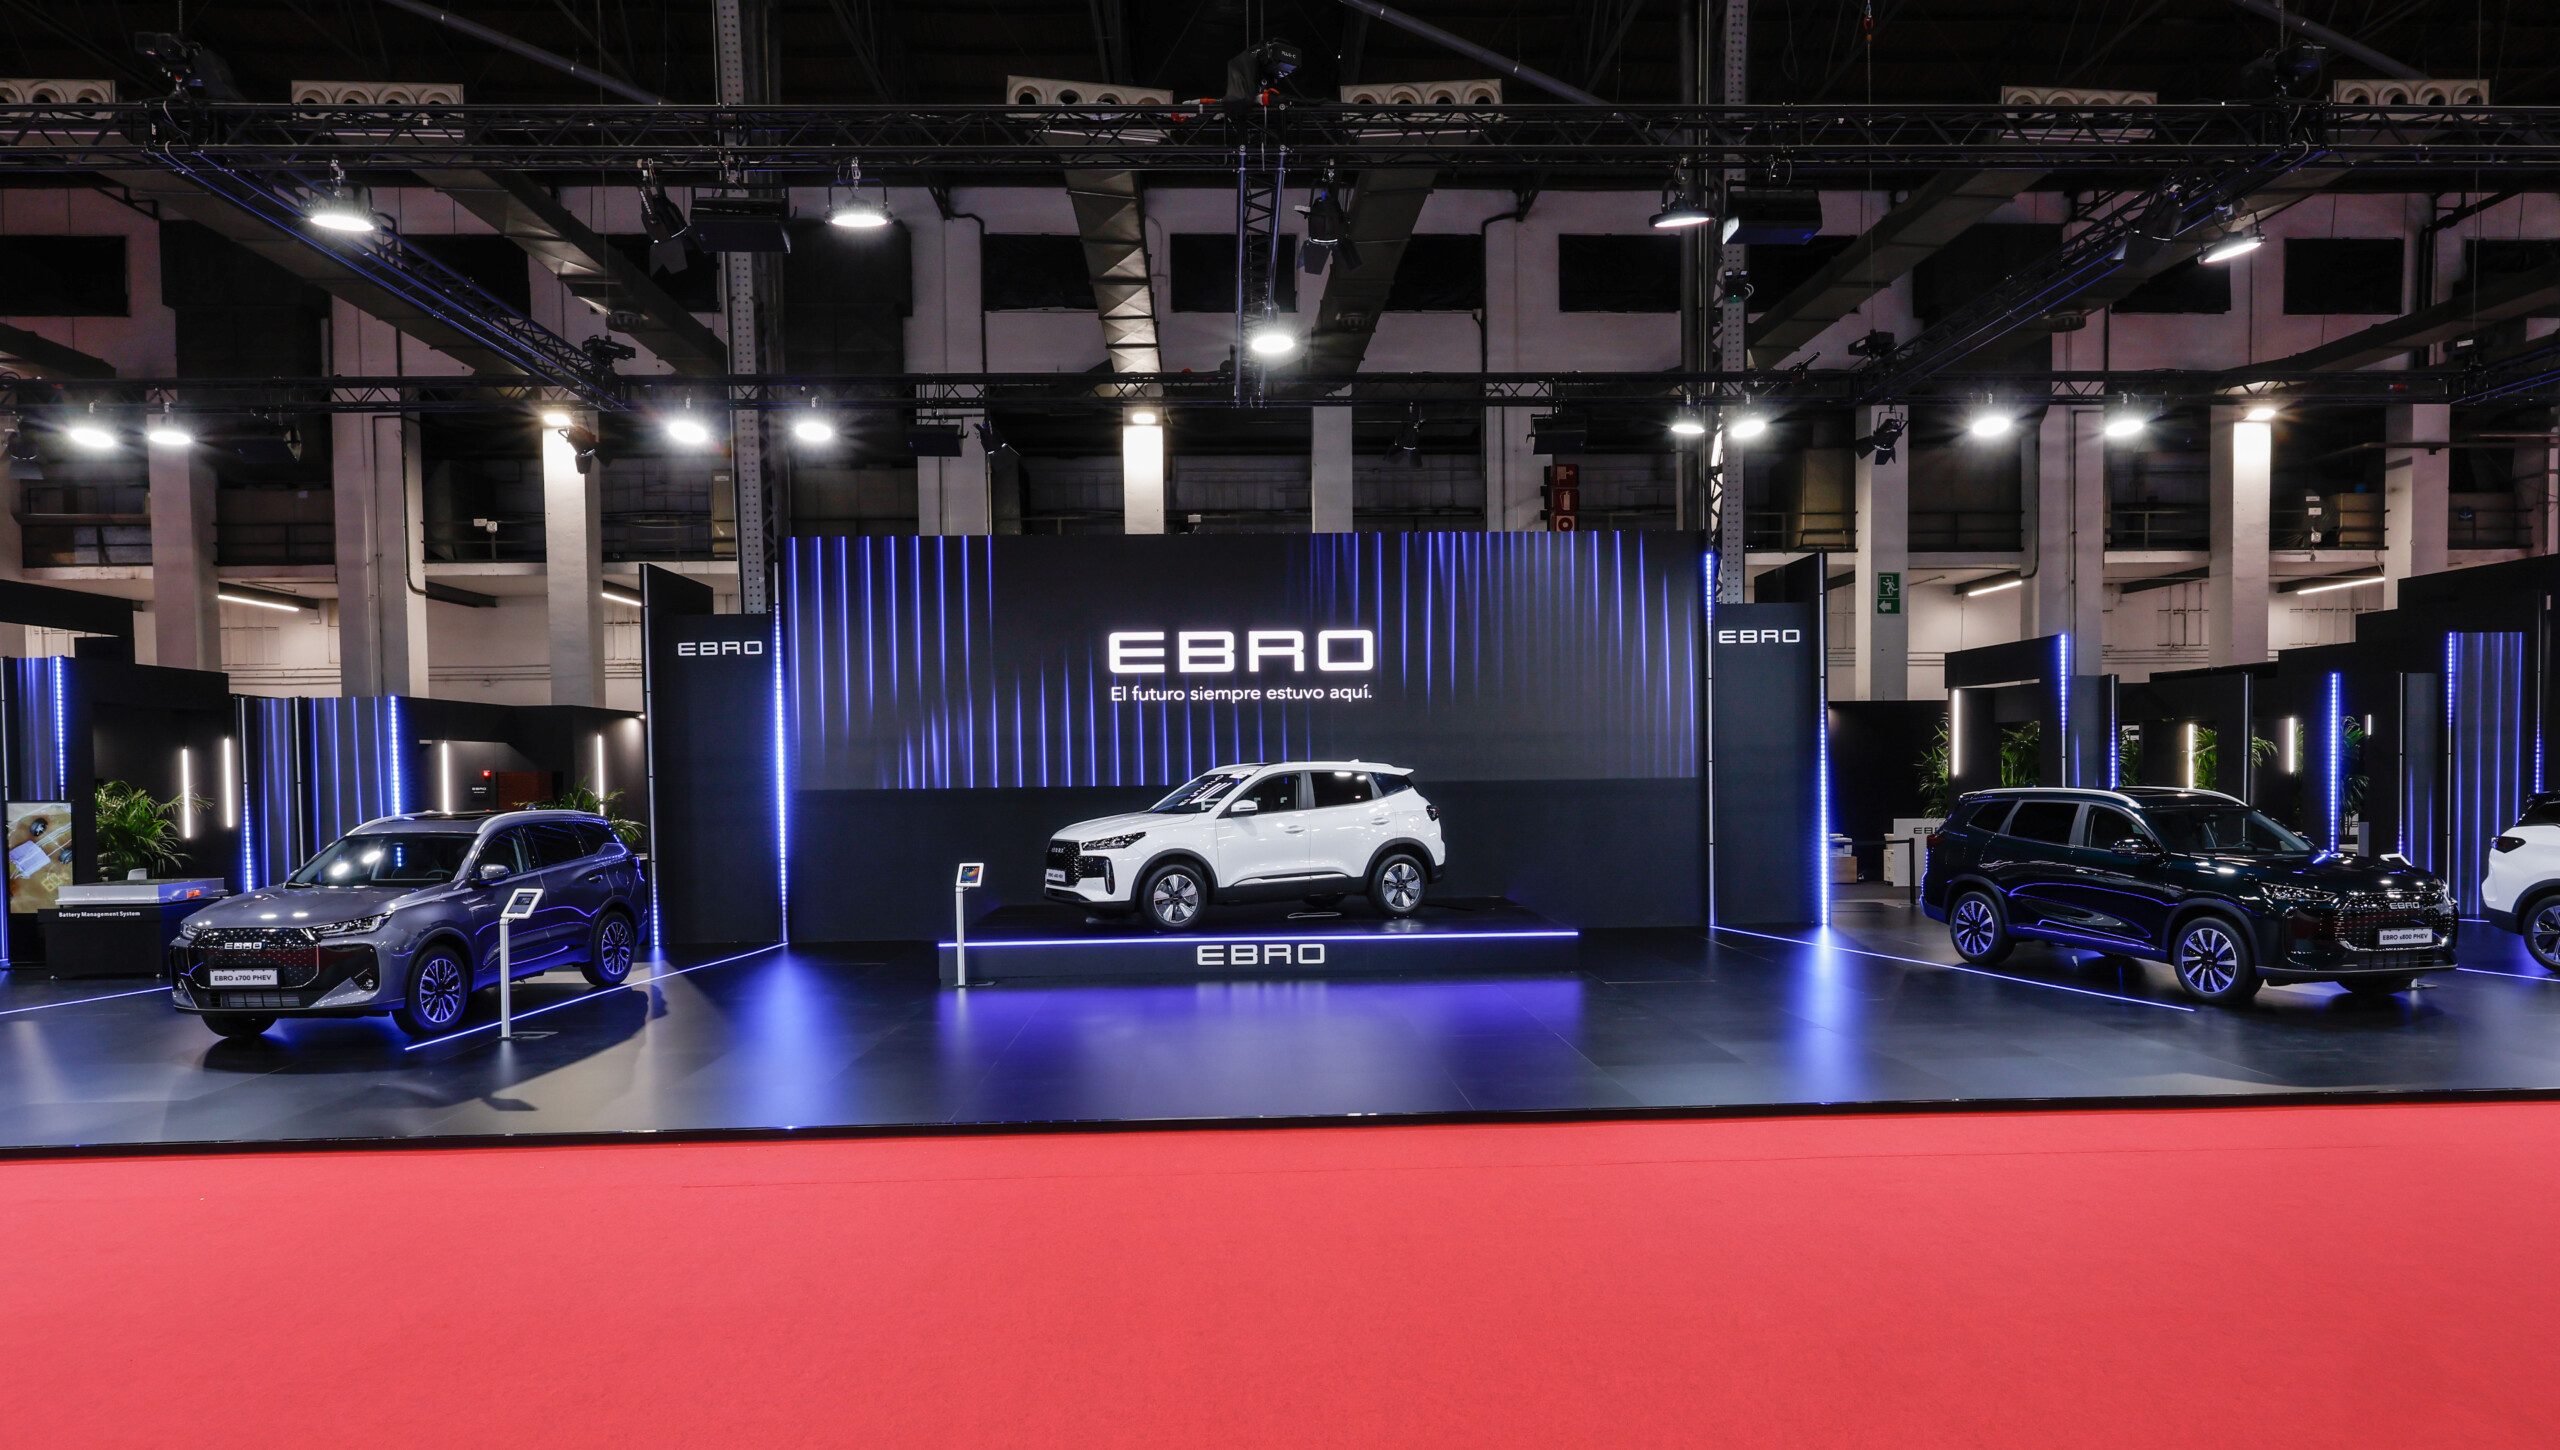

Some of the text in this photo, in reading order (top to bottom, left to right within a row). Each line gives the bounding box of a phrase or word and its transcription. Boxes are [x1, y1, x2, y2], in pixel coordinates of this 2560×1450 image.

[1719, 630, 1801, 644] EBRO
[677, 641, 763, 657] EBRO
[1108, 629, 1374, 673] EBRO
[1111, 684, 1373, 704] El futuro siempre estuvo aquí.
[2389, 902, 2420, 910] EBRO
[81, 911, 119, 919] Management
[224, 942, 263, 950] EBRO
[1197, 943, 1326, 966] EBRO
